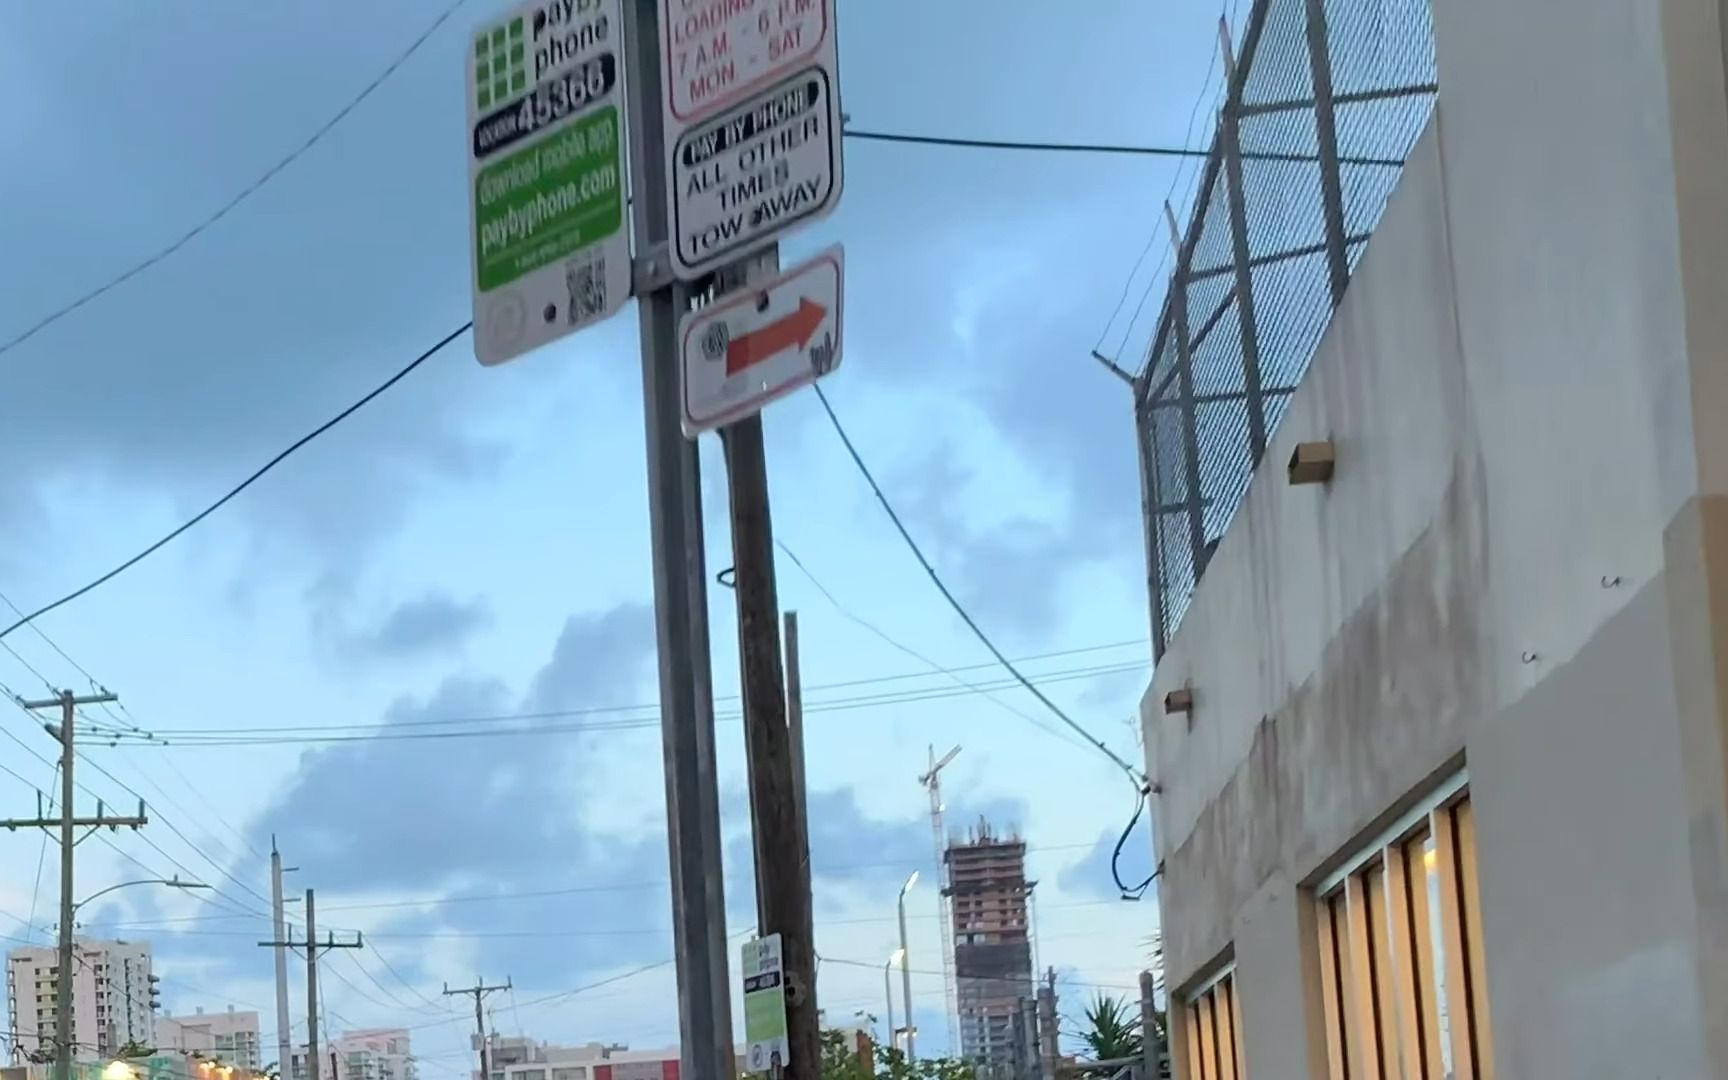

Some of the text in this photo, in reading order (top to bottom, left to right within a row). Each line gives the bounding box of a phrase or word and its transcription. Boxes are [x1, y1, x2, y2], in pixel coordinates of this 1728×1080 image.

[535, 15, 608, 81] phone
[674, 0, 753, 44] LOADIN
[689, 60, 735, 102] MON
[768, 23, 803, 61] SAT
[686, 115, 819, 198] ALL OTHER
[691, 86, 808, 163] PAY BY PHONE
[481, 163, 616, 257] paybyphone.com
[689, 173, 822, 255] TOW AWAY
[719, 157, 789, 212] TIMES
